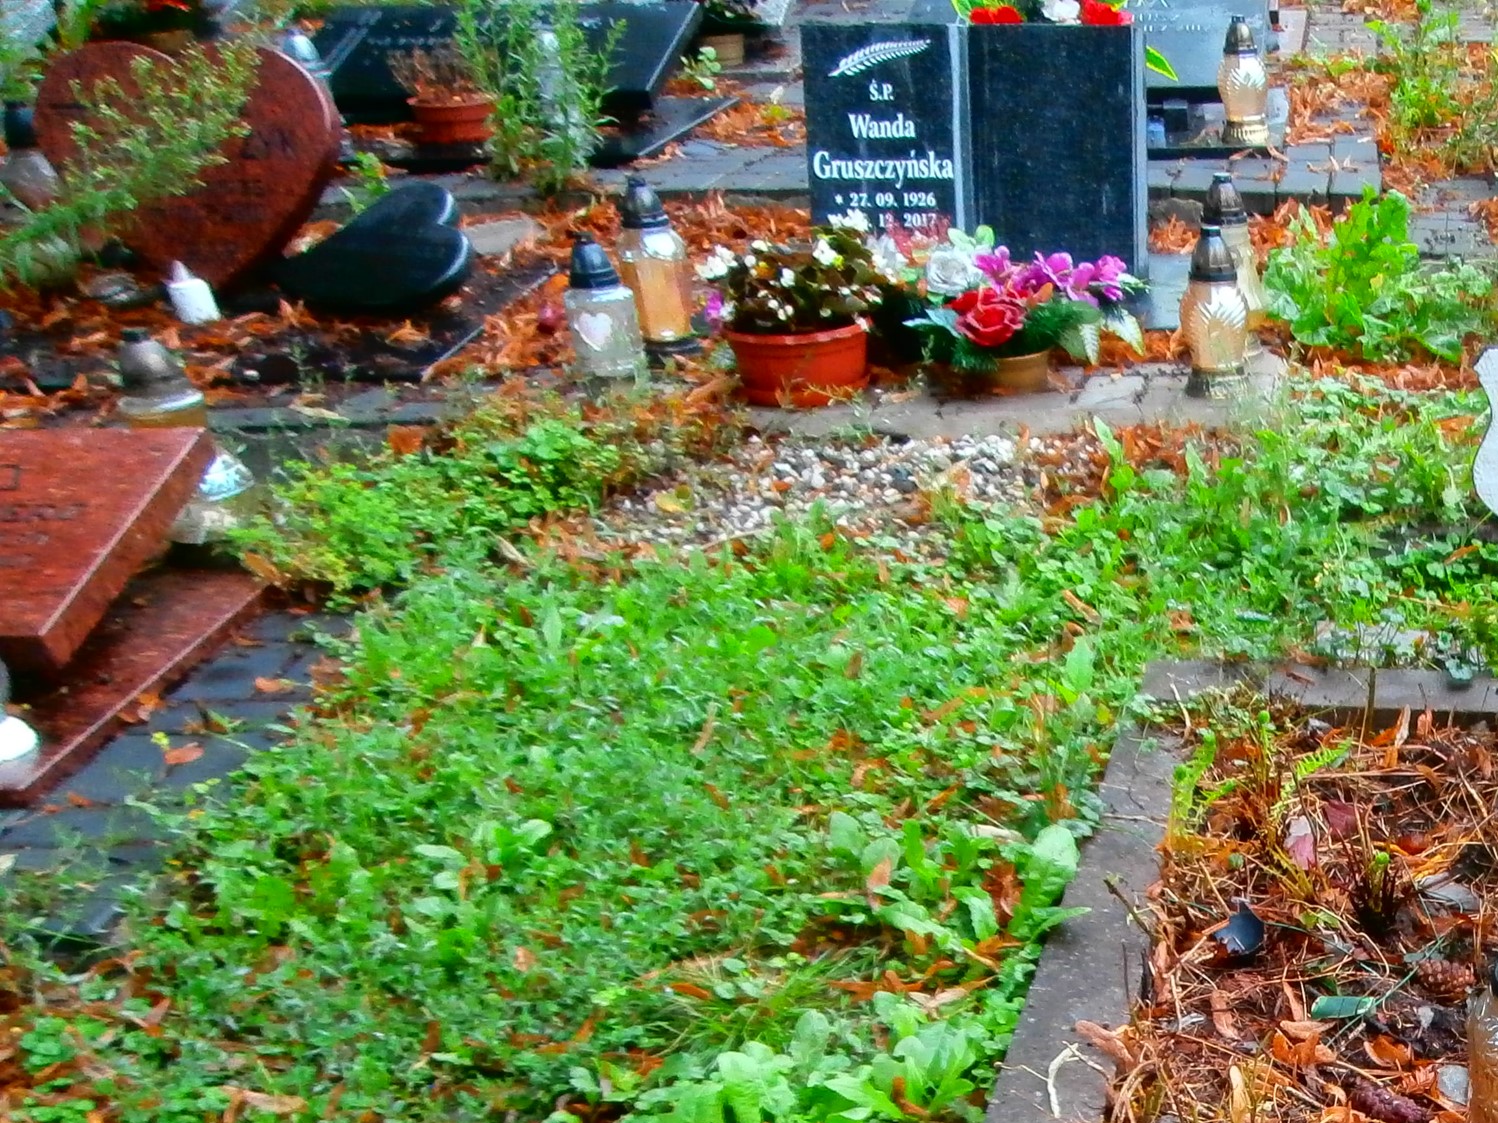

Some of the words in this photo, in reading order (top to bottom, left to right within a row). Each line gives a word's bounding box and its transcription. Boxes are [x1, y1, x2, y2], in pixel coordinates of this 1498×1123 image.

[847, 111, 916, 139] Wanda
[812, 149, 954, 189] Gruszczyńska
[903, 192, 937, 207] 1926
